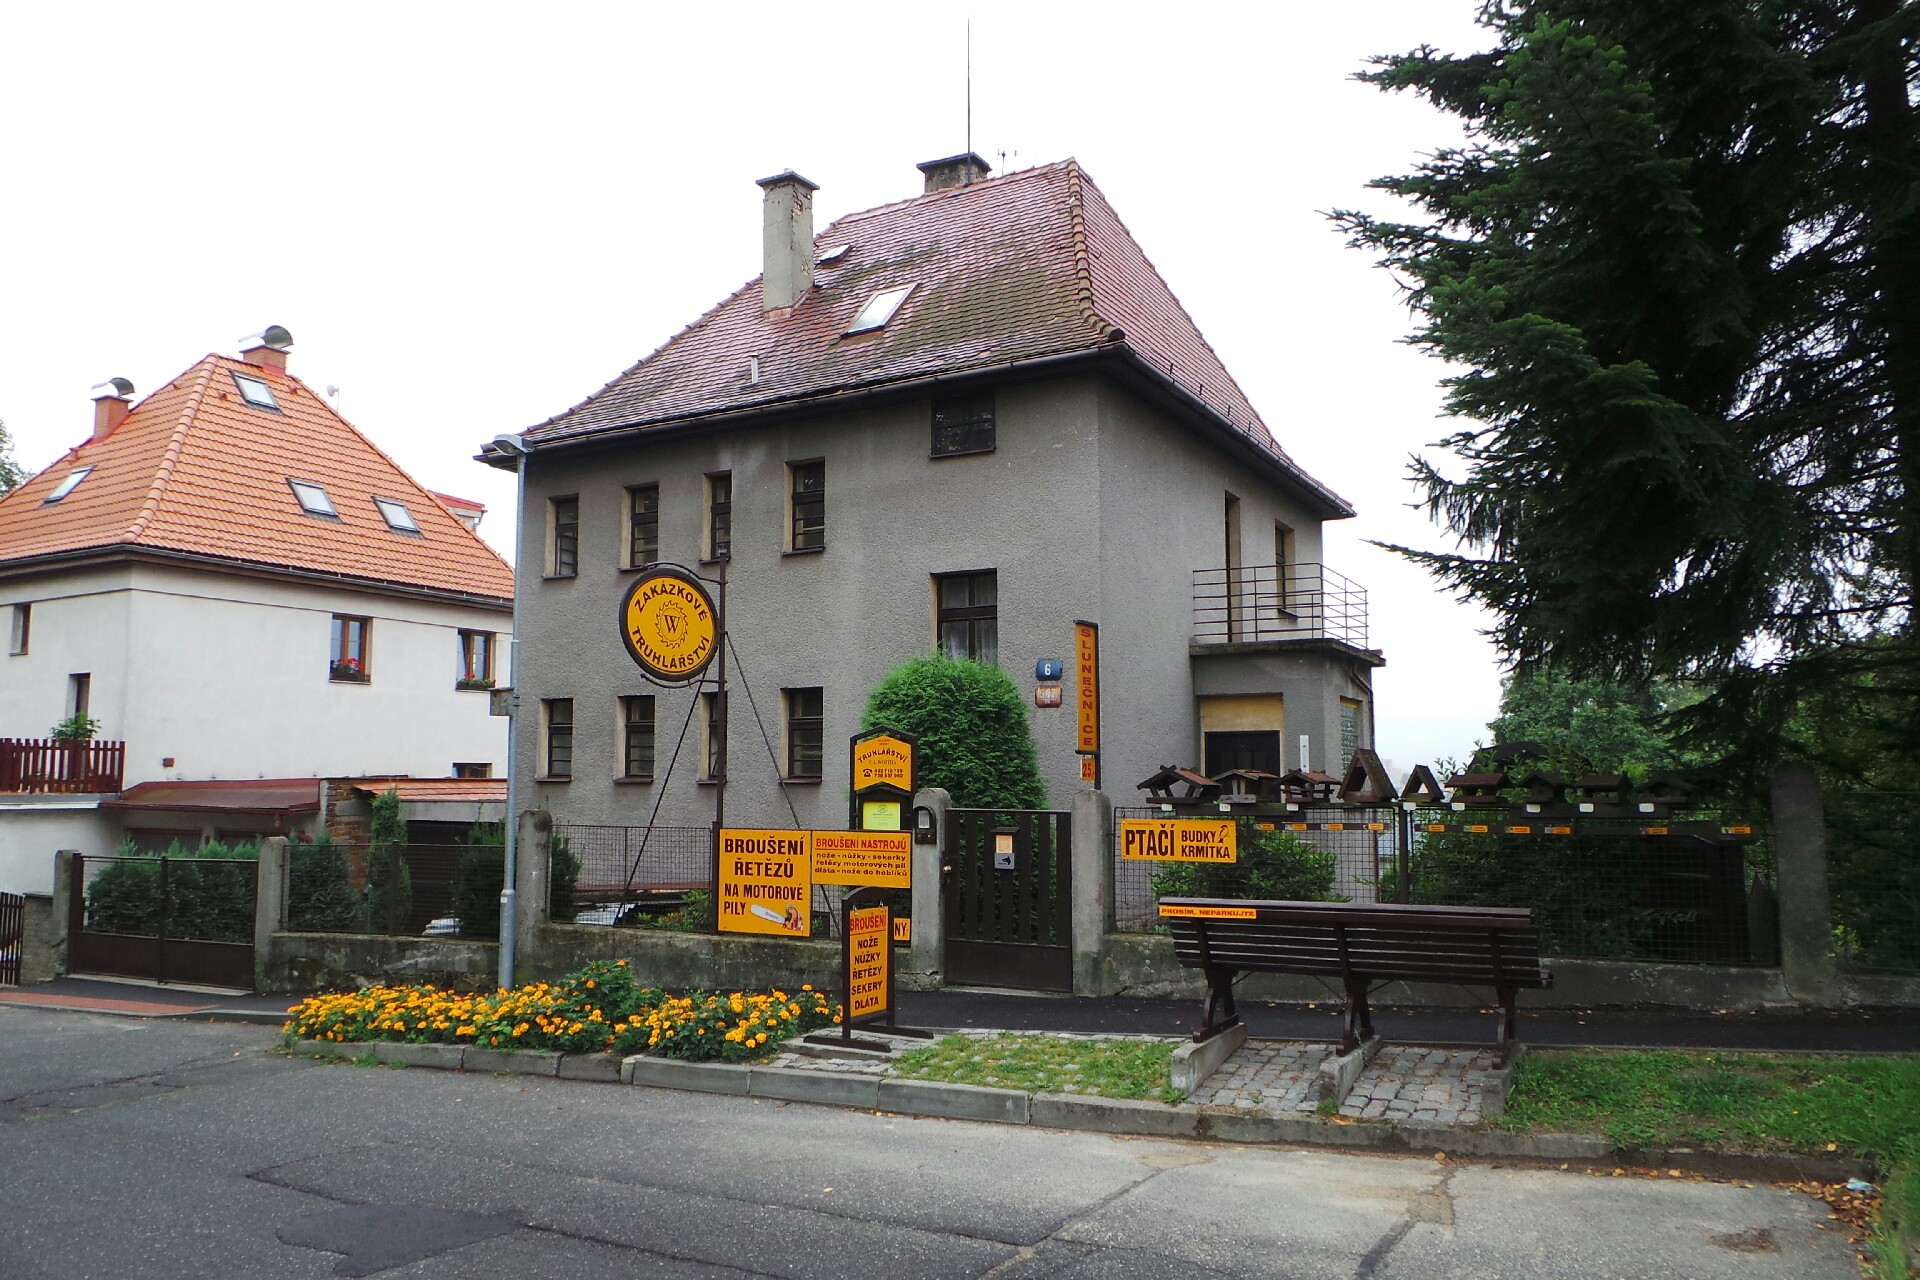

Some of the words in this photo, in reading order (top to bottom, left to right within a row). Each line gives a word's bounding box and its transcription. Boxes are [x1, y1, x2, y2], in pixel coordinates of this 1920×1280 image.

[634, 580, 708, 622] ZAKÁZKOVÉ
[664, 614, 680, 634] W
[632, 626, 710, 669] TRUHLÁŘSTVÍ
[1044, 663, 1052, 676] 6
[1081, 628, 1095, 746] SLUNEČNICE
[858, 747, 908, 764] TRUHLÁŘSTVÍ
[816, 836, 860, 848] BROUŠENÍ
[1125, 823, 1176, 856] PTAČÍ
[1182, 830, 1217, 843] BUDKY
[724, 835, 805, 856] BROUŠENÍ
[1182, 842, 1230, 859] KRMÍTKA
[872, 854, 906, 862] sekerky
[734, 858, 794, 878] ŘETĚZŮ
[724, 884, 739, 897] NA
[743, 883, 804, 900] MOTOROVÉ
[724, 901, 746, 916] PILY
[850, 910, 886, 932] BROUŠENÍ
[858, 936, 878, 950] NOŽE
[852, 966, 883, 980] ŘETĚZY
[852, 980, 883, 996] SEKERY
[854, 996, 880, 1010] DLÁTA
